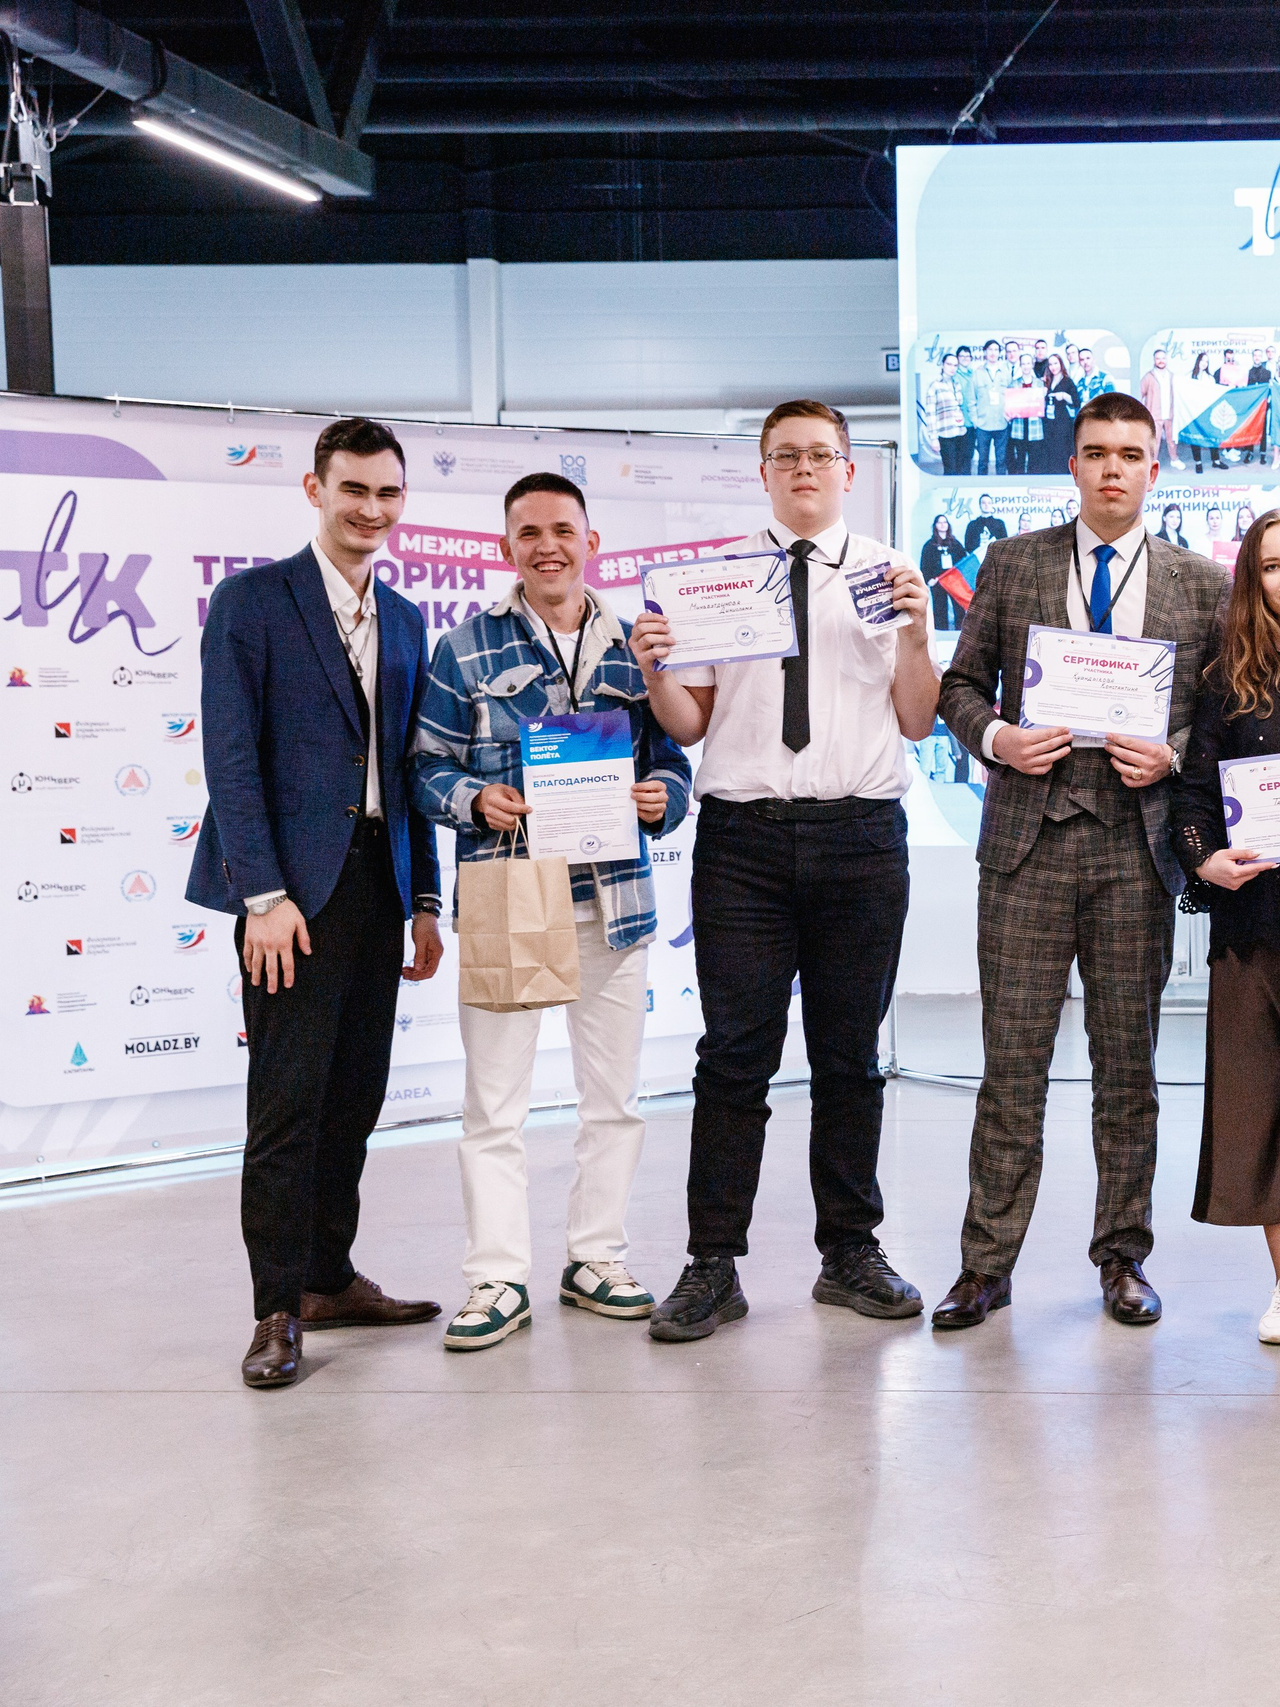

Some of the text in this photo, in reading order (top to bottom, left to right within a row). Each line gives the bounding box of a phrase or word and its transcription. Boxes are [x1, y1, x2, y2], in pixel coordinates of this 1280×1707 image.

[399, 531, 502, 561] МЕЖРЕ
[678, 579, 754, 596] СЕРТИФИКАТ
[1063, 655, 1140, 671] СЕРТИФИКАТ
[529, 744, 558, 753] ВЕКТОР
[530, 752, 561, 760] ПОЛЁТА
[533, 774, 620, 789] БЛАГОДАРНОСТЬ
[651, 851, 682, 862] DZ.BY
[125, 1036, 201, 1055] MOLADZ.BY
